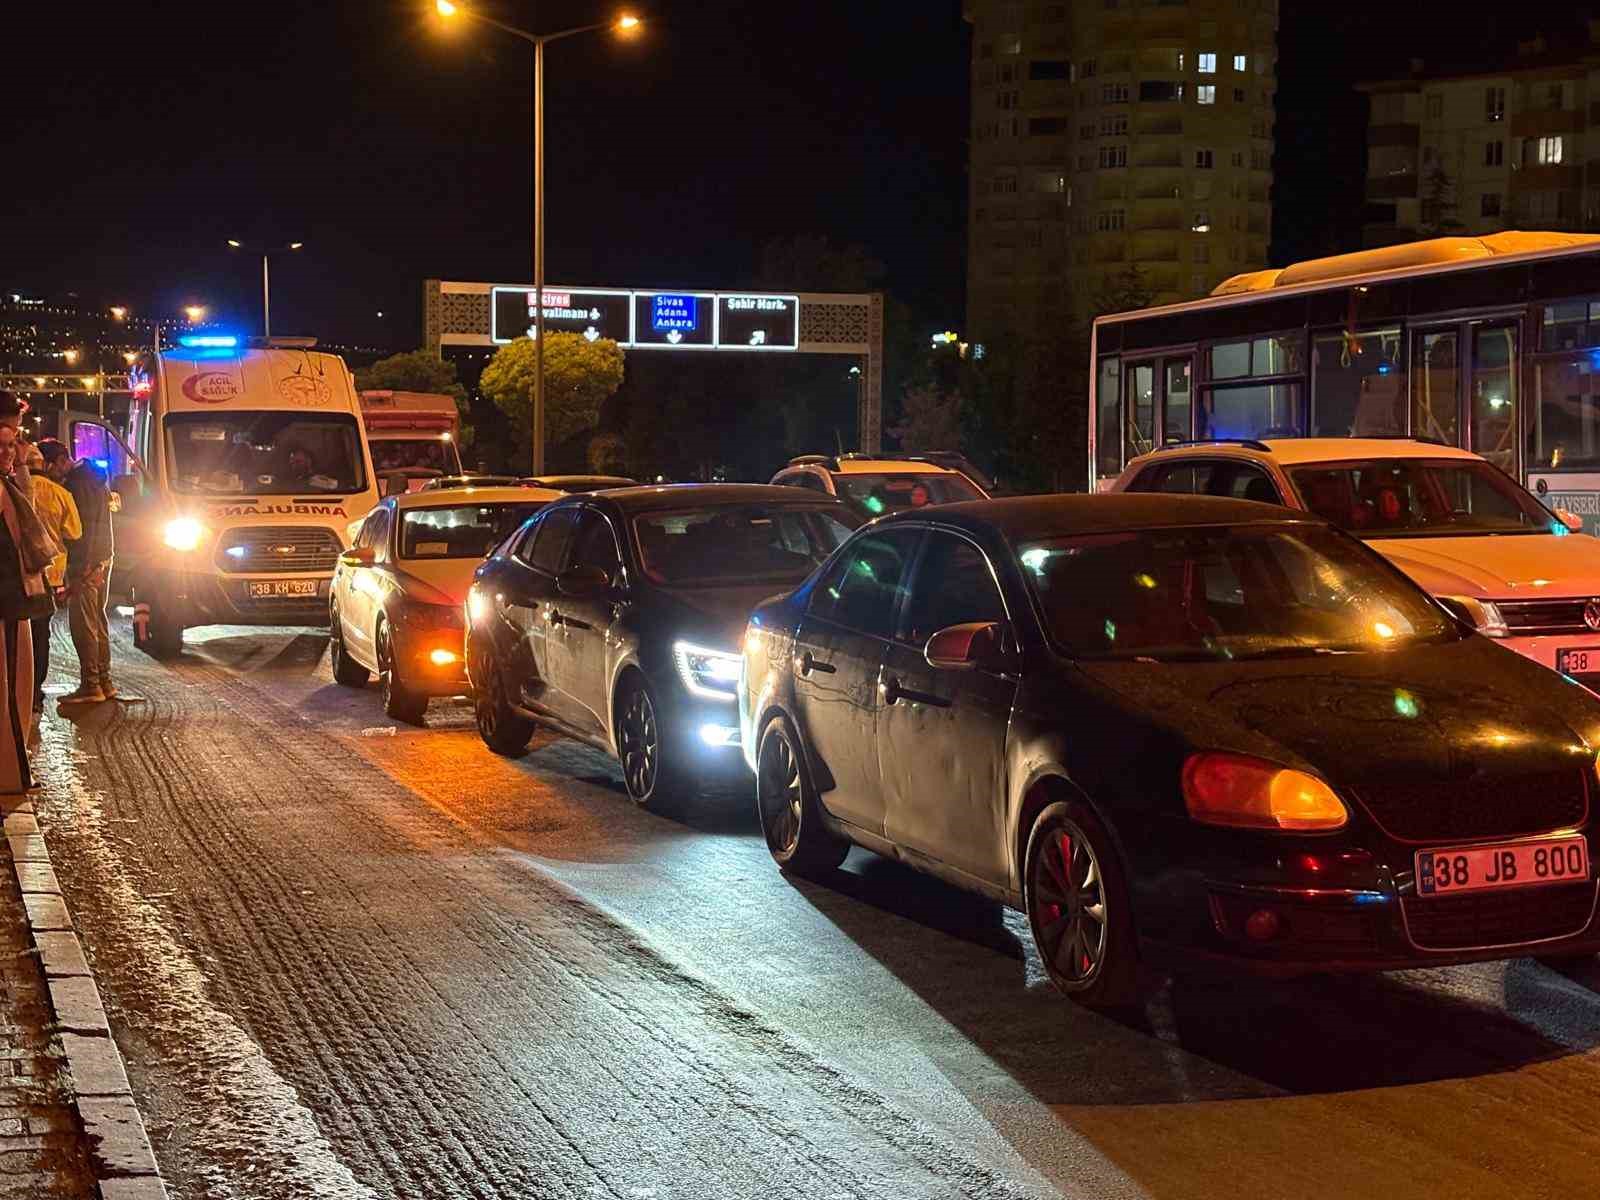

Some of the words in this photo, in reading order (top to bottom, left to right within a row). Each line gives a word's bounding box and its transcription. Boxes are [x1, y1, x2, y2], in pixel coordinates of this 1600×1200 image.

[657, 297, 684, 307] Sivas
[528, 306, 588, 319] Hvalimanı
[656, 308, 688, 317] Adana
[656, 318, 693, 328] Ankara
[256, 583, 270, 595] 38
[275, 583, 289, 593] KH
[295, 582, 314, 593] 620
[1570, 652, 1588, 670] 38
[1435, 855, 1470, 887] 38
[1485, 850, 1518, 883] JB
[1534, 844, 1583, 877] 800
[1423, 875, 1434, 887] TR
